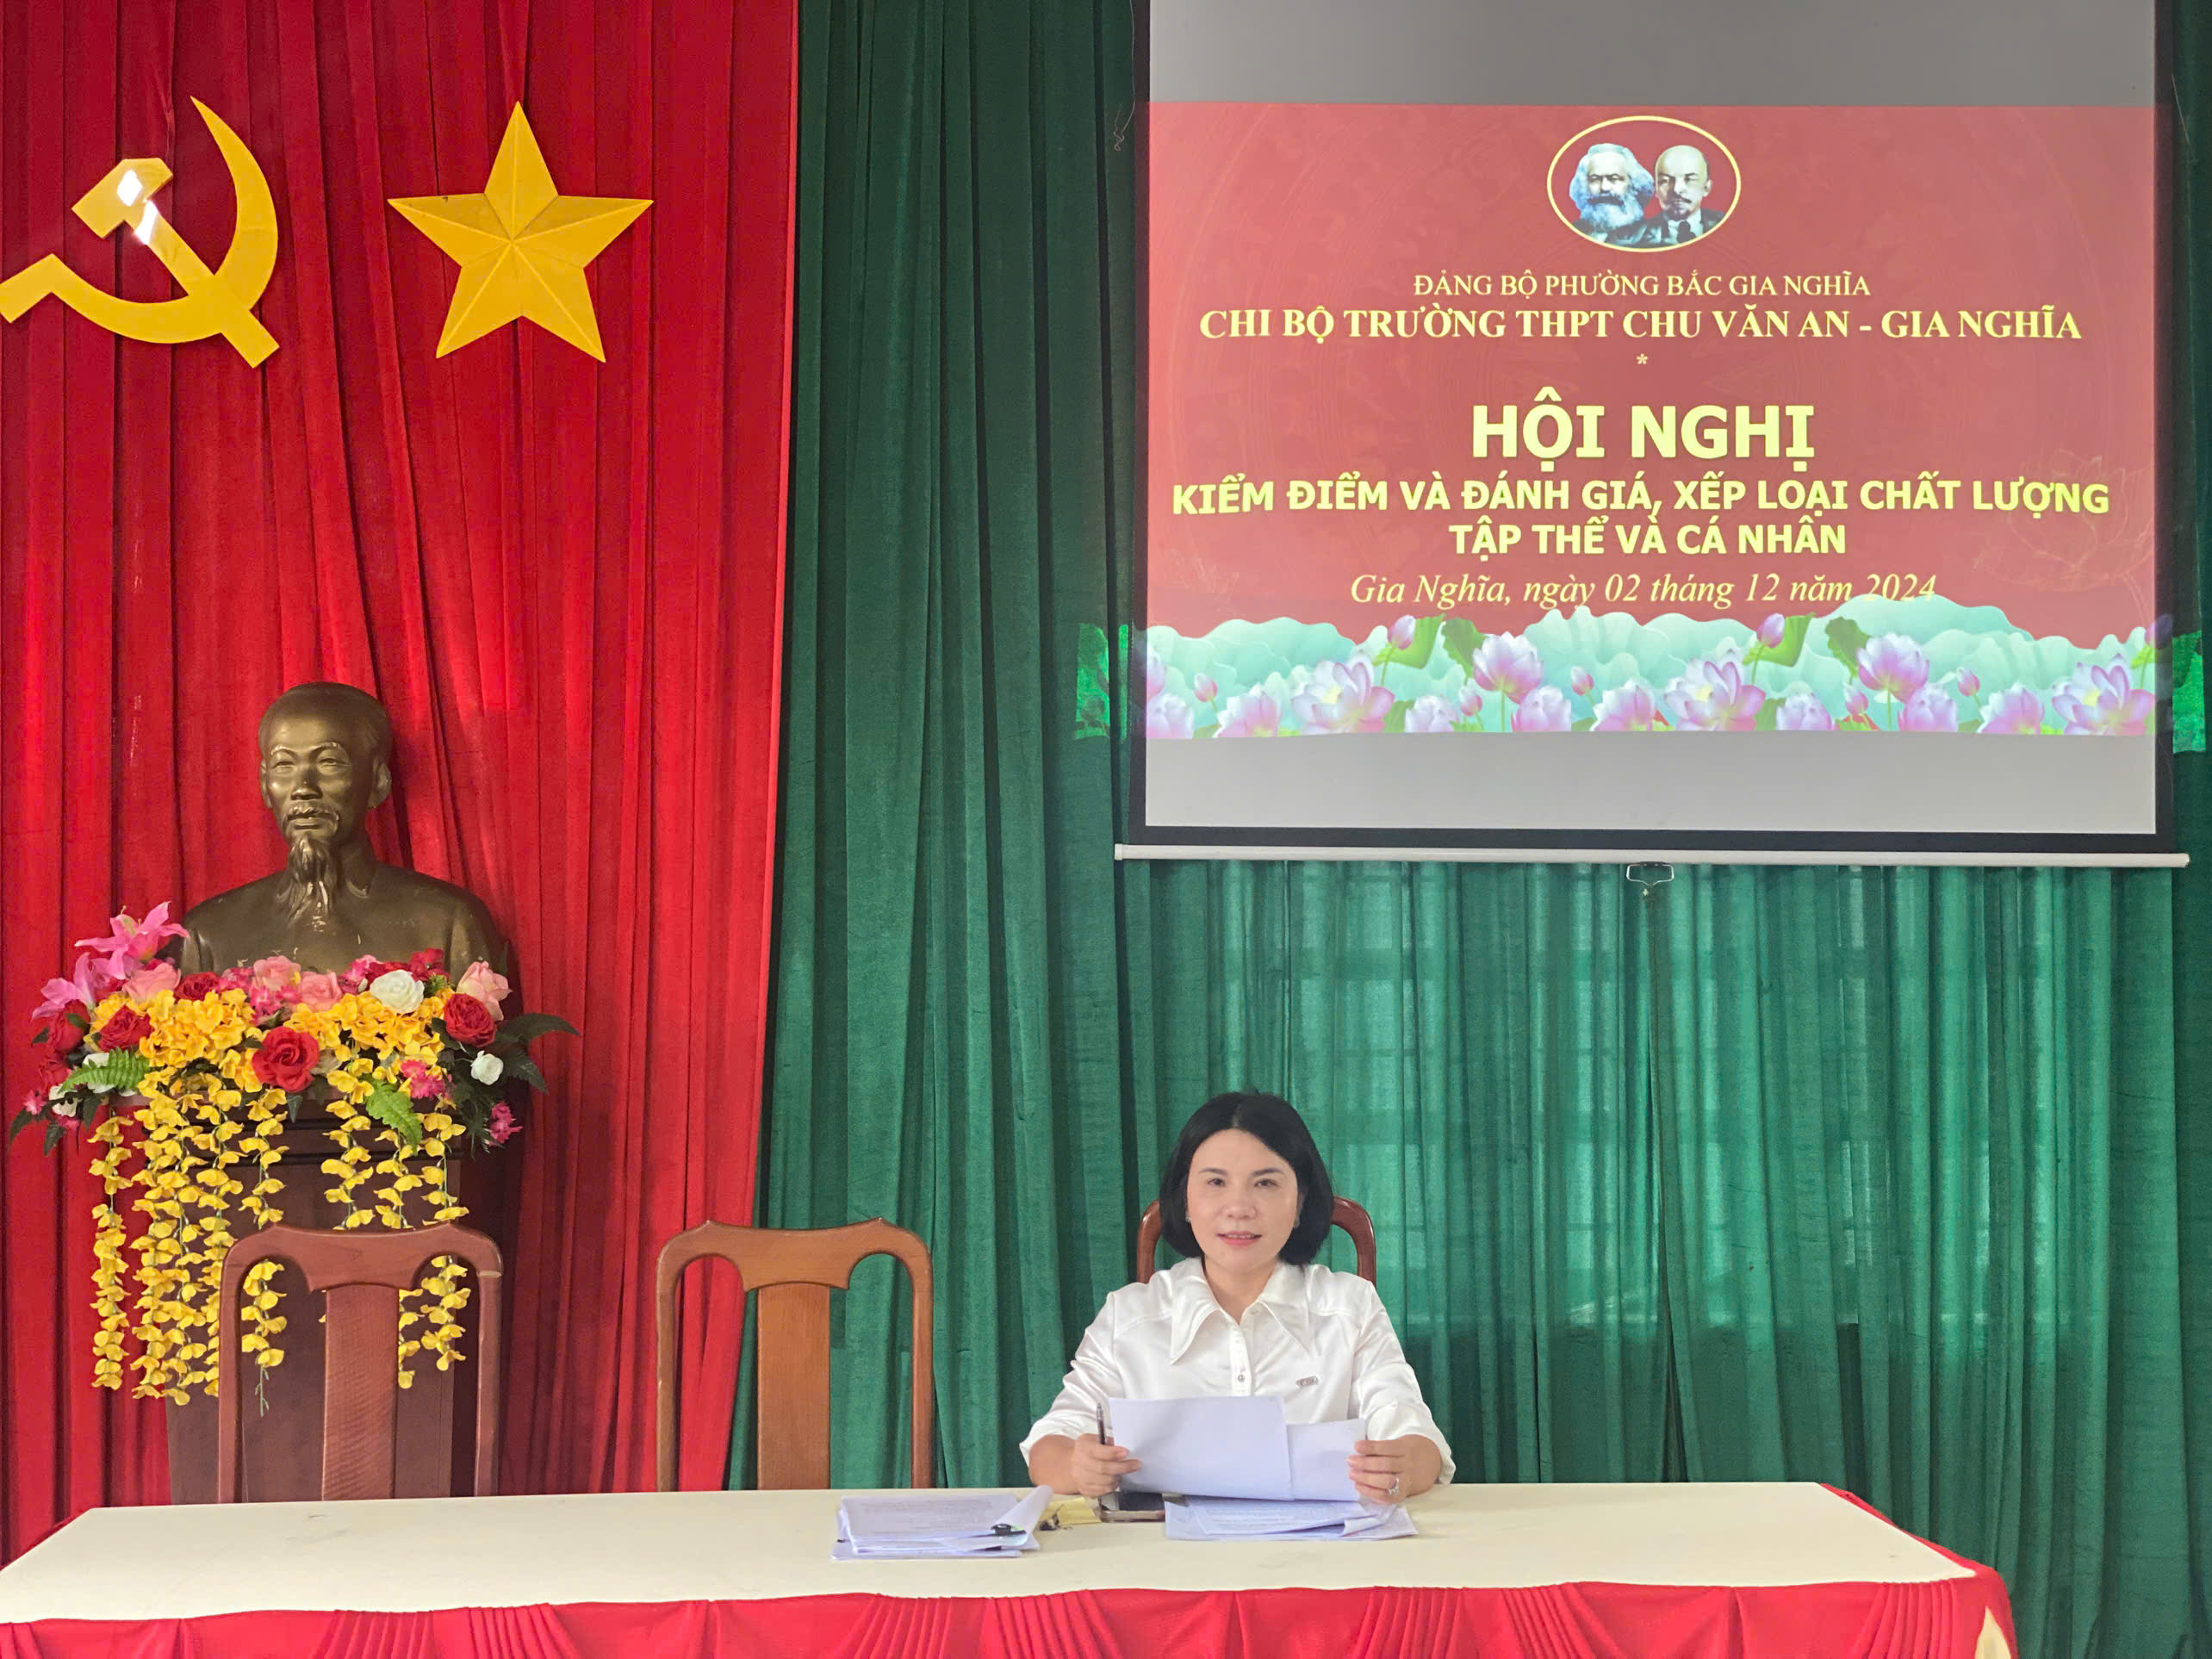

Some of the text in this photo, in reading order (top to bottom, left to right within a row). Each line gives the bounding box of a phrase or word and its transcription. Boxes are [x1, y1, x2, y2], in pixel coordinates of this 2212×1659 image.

[1414, 270, 1871, 299] ĐẢNG BỘ PHƯỜNG BẮC GIA NGHĨA
[1200, 309, 1271, 339] CHI
[1282, 306, 1334, 344] BỘ
[1344, 303, 1506, 339] TRƯỜNG
[1516, 311, 1614, 339] THPT
[1623, 311, 1702, 338] CHU
[1712, 304, 1789, 338] VĂN
[1798, 311, 1849, 338] AN
[1881, 310, 1950, 339] GIA
[1958, 305, 2082, 339] NGHĨA
[1472, 386, 1815, 472] HỘI NGHỊ
[1172, 470, 2109, 519] KIỂM ĐIỂM VÀ ĐÁNH GIÁ, XẾP LOẠI CHẤT LƯỢNG
[1449, 514, 1846, 562] TẬP THỂ VÀ CÁ NHÂN
[1351, 574, 1937, 610] Gia Nghĩa, ngày 02 tháng 12 năm 2024
